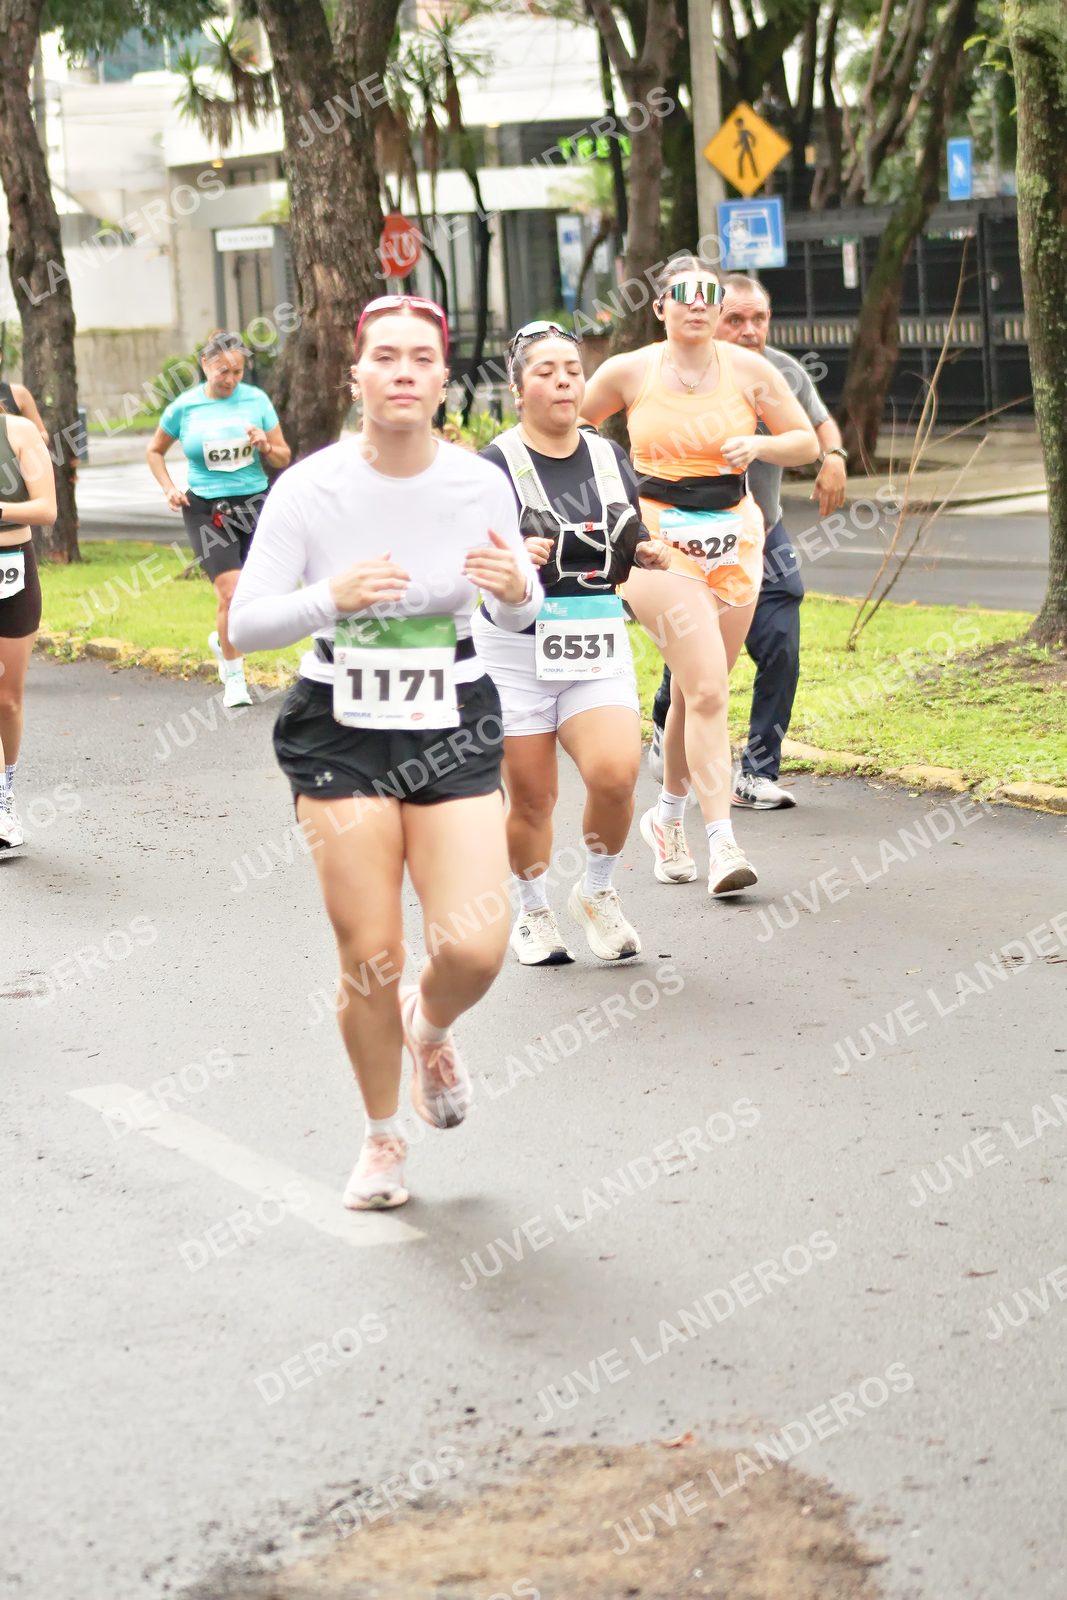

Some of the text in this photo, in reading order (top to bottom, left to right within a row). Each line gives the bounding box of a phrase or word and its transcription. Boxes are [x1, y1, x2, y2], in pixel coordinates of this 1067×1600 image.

[208, 446, 252, 462] 6210
[543, 633, 614, 660] 6531
[346, 668, 444, 702] 1171
